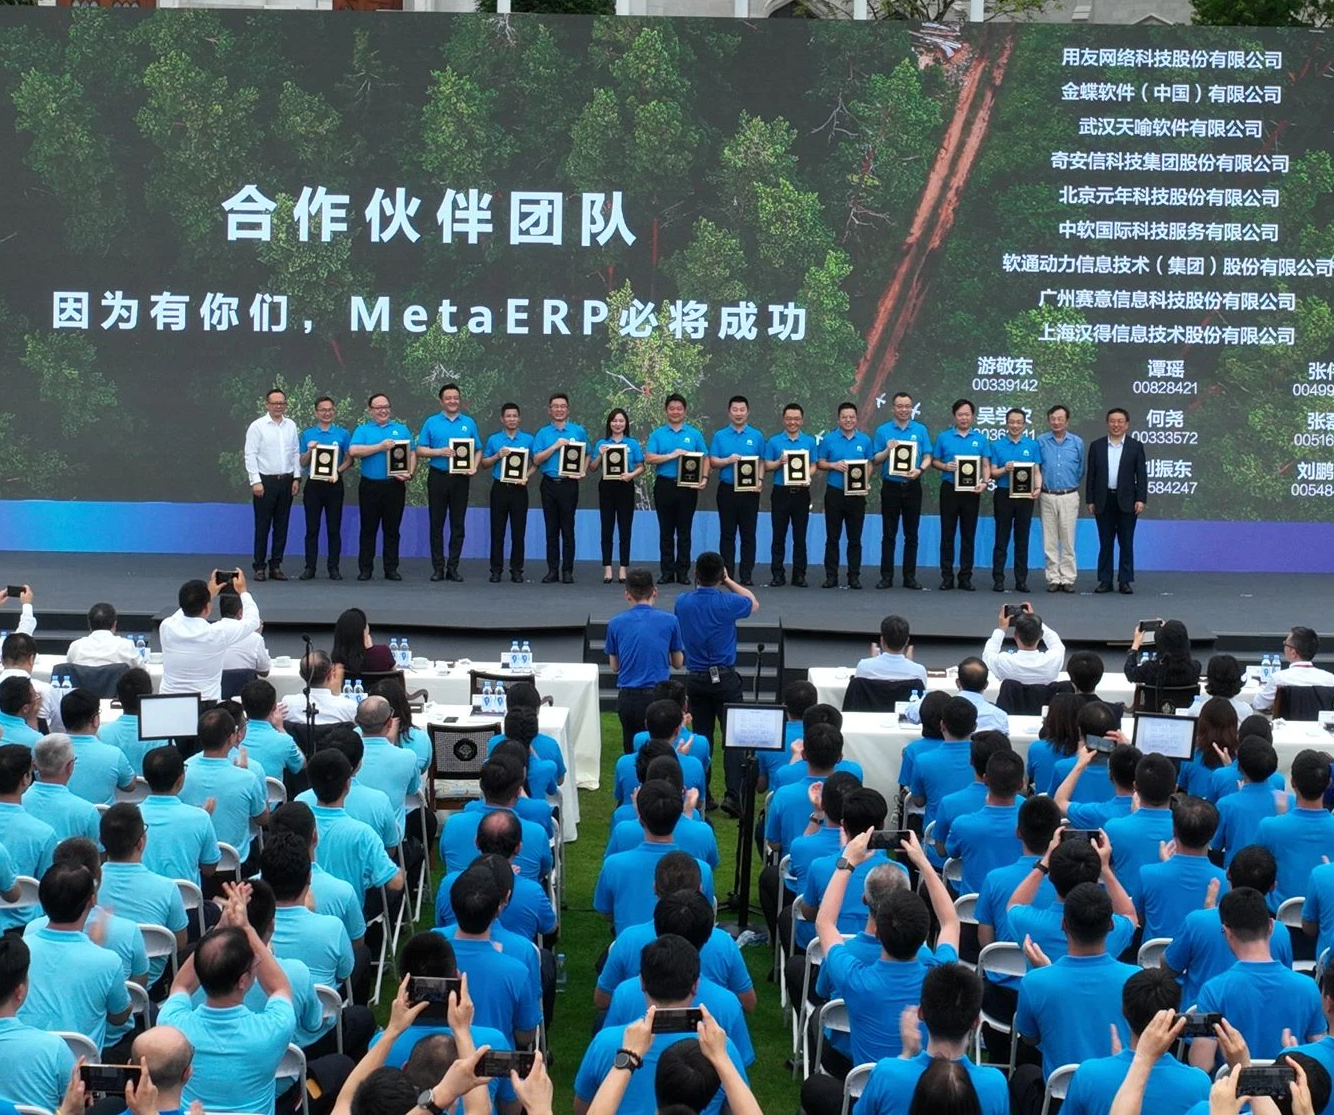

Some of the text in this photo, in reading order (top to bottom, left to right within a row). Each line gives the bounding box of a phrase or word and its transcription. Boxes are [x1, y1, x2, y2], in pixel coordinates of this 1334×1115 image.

[1061, 47, 1282, 70] 用友网络科技股份有限公司
[1078, 116, 1264, 138] 武汉天喻软件有限公司
[1050, 150, 1290, 173] 奇安信科技集团股份有限公司
[1058, 185, 1280, 208] 北京元年科技股份有限公司
[222, 185, 635, 246] 合作伙伴团队
[1059, 219, 1279, 242] 中软国际科技服务有限公司
[1038, 288, 1296, 311] 广州赛意信息科技股份有限公司
[1037, 323, 1295, 346] 上海汉得信息技术股份有限公司
[977, 356, 1034, 376] 游敬东
[1147, 359, 1185, 379] 谭瑶
[972, 378, 1039, 392] 00339142
[1132, 380, 1198, 395] 00828421
[1146, 408, 1184, 428] 何尧
[1131, 430, 1199, 445] 00333572
